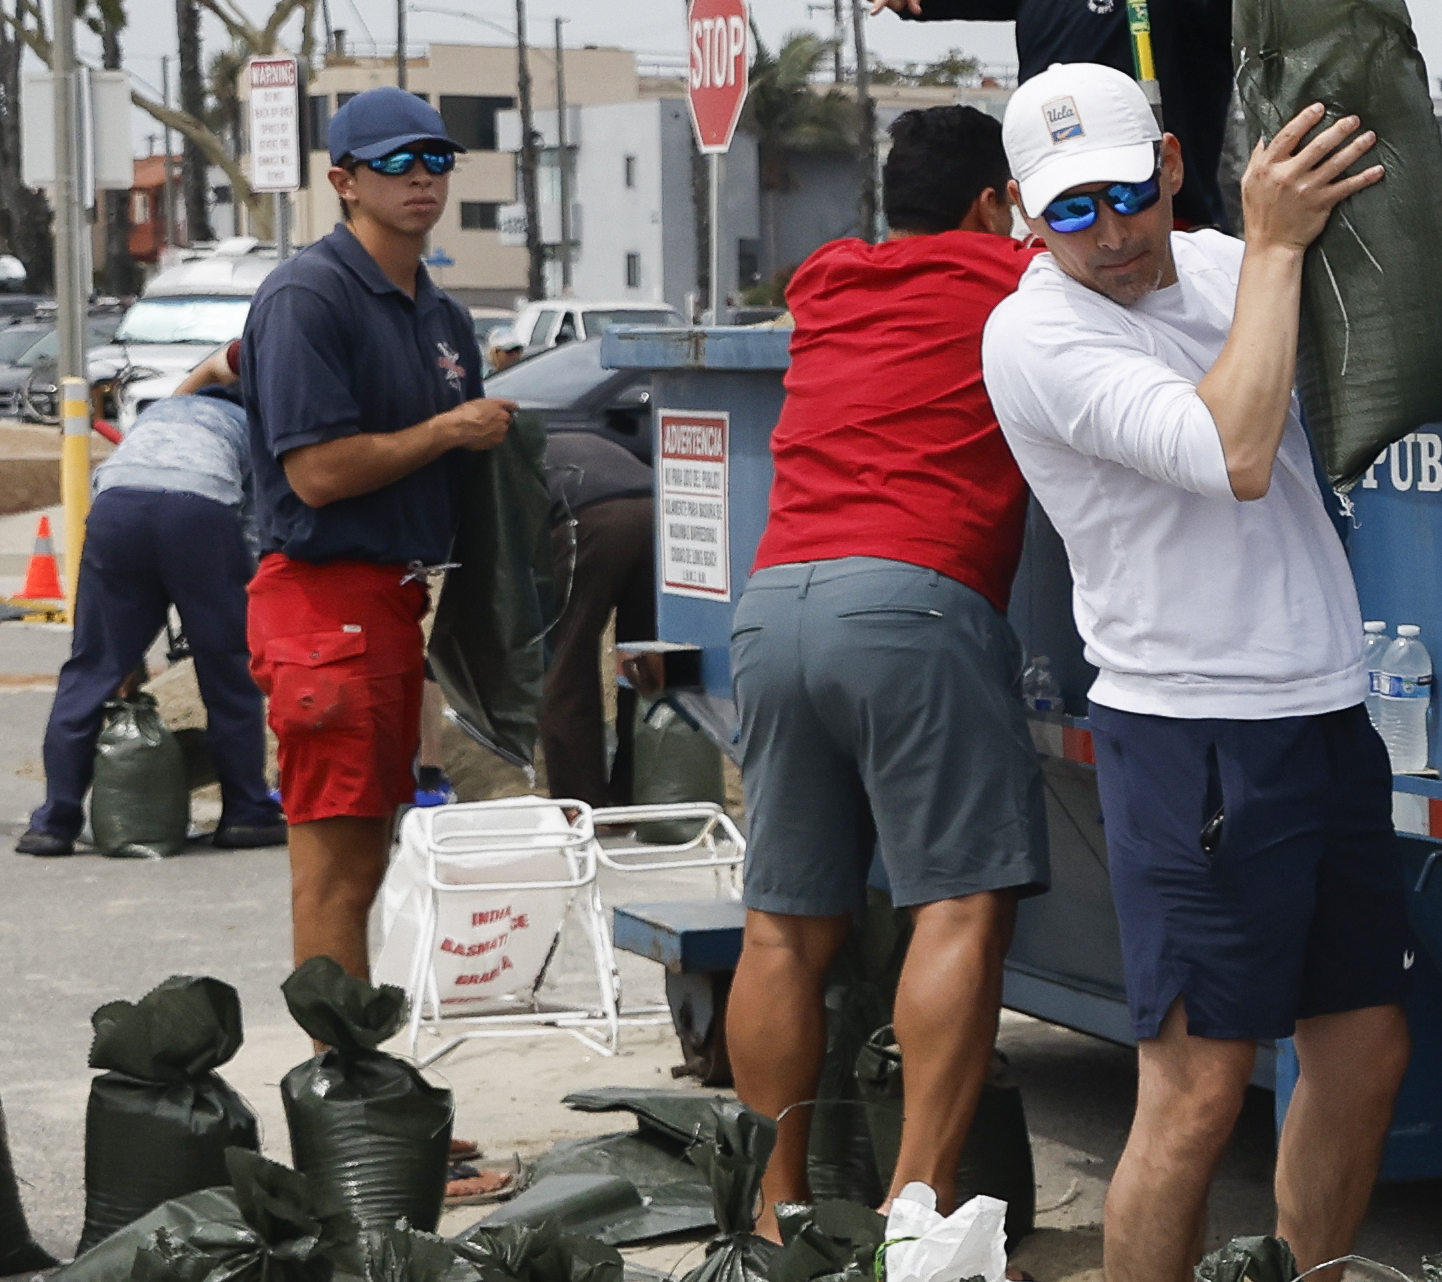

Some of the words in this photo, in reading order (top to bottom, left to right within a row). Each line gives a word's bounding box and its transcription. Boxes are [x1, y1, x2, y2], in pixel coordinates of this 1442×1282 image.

[691, 15, 745, 90] STOP
[252, 63, 295, 85] WARNING
[664, 424, 724, 457] ADVERTENCIA
